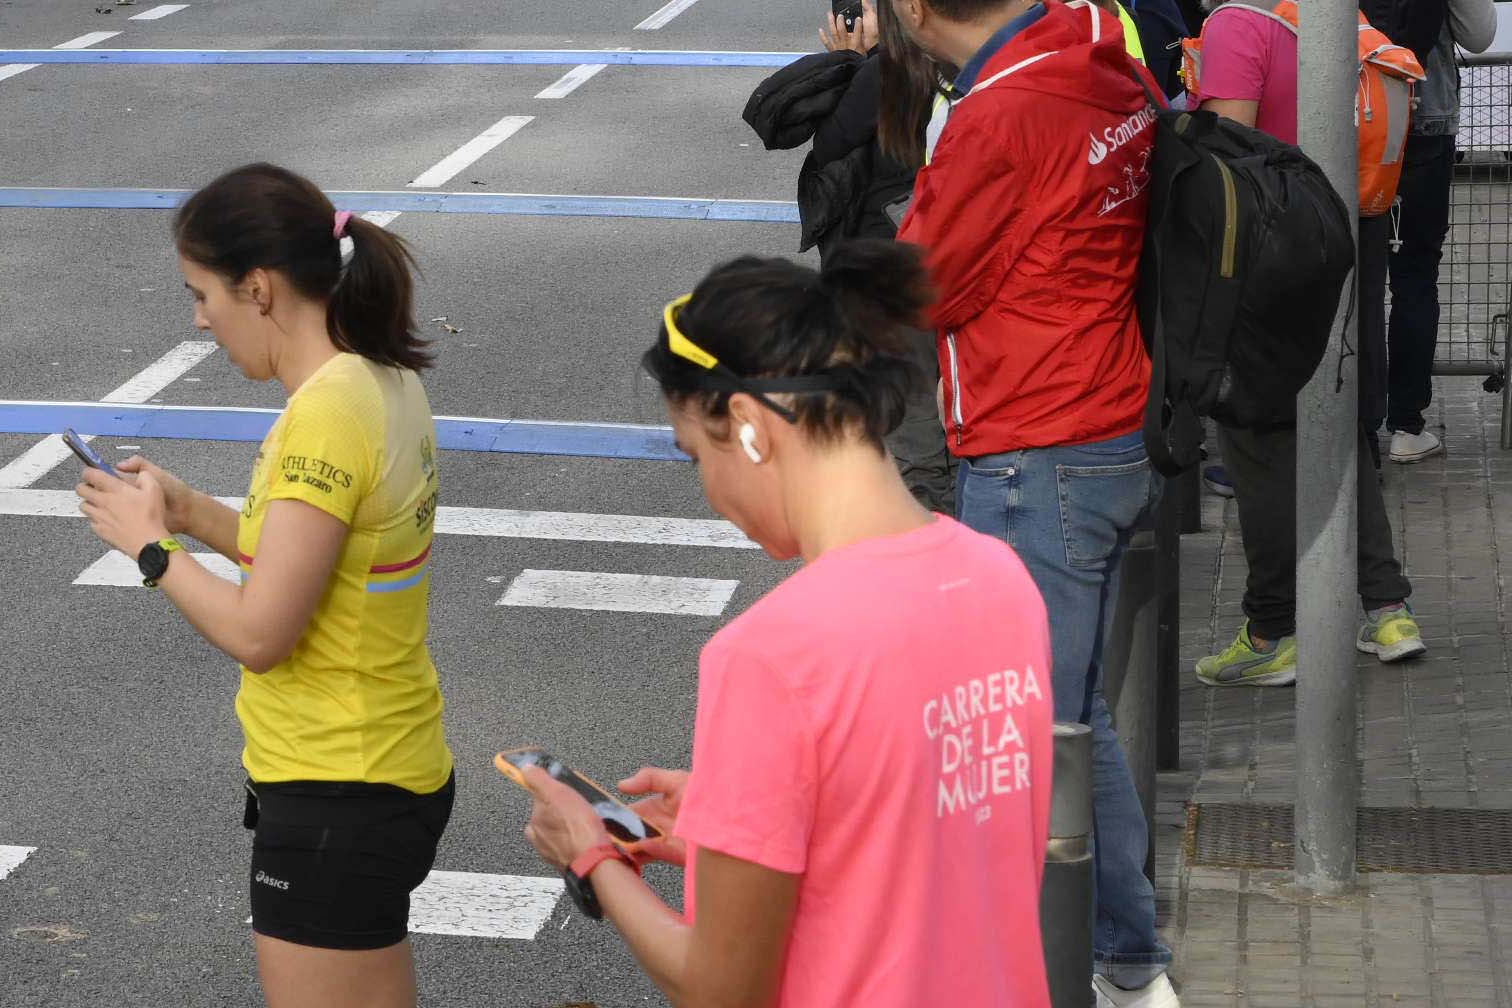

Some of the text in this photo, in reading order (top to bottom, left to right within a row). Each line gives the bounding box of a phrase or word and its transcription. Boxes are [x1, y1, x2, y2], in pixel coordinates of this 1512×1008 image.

[922, 663, 1043, 740] CARRERA
[941, 710, 1025, 775] DE LA
[936, 750, 1032, 819] MUJER
